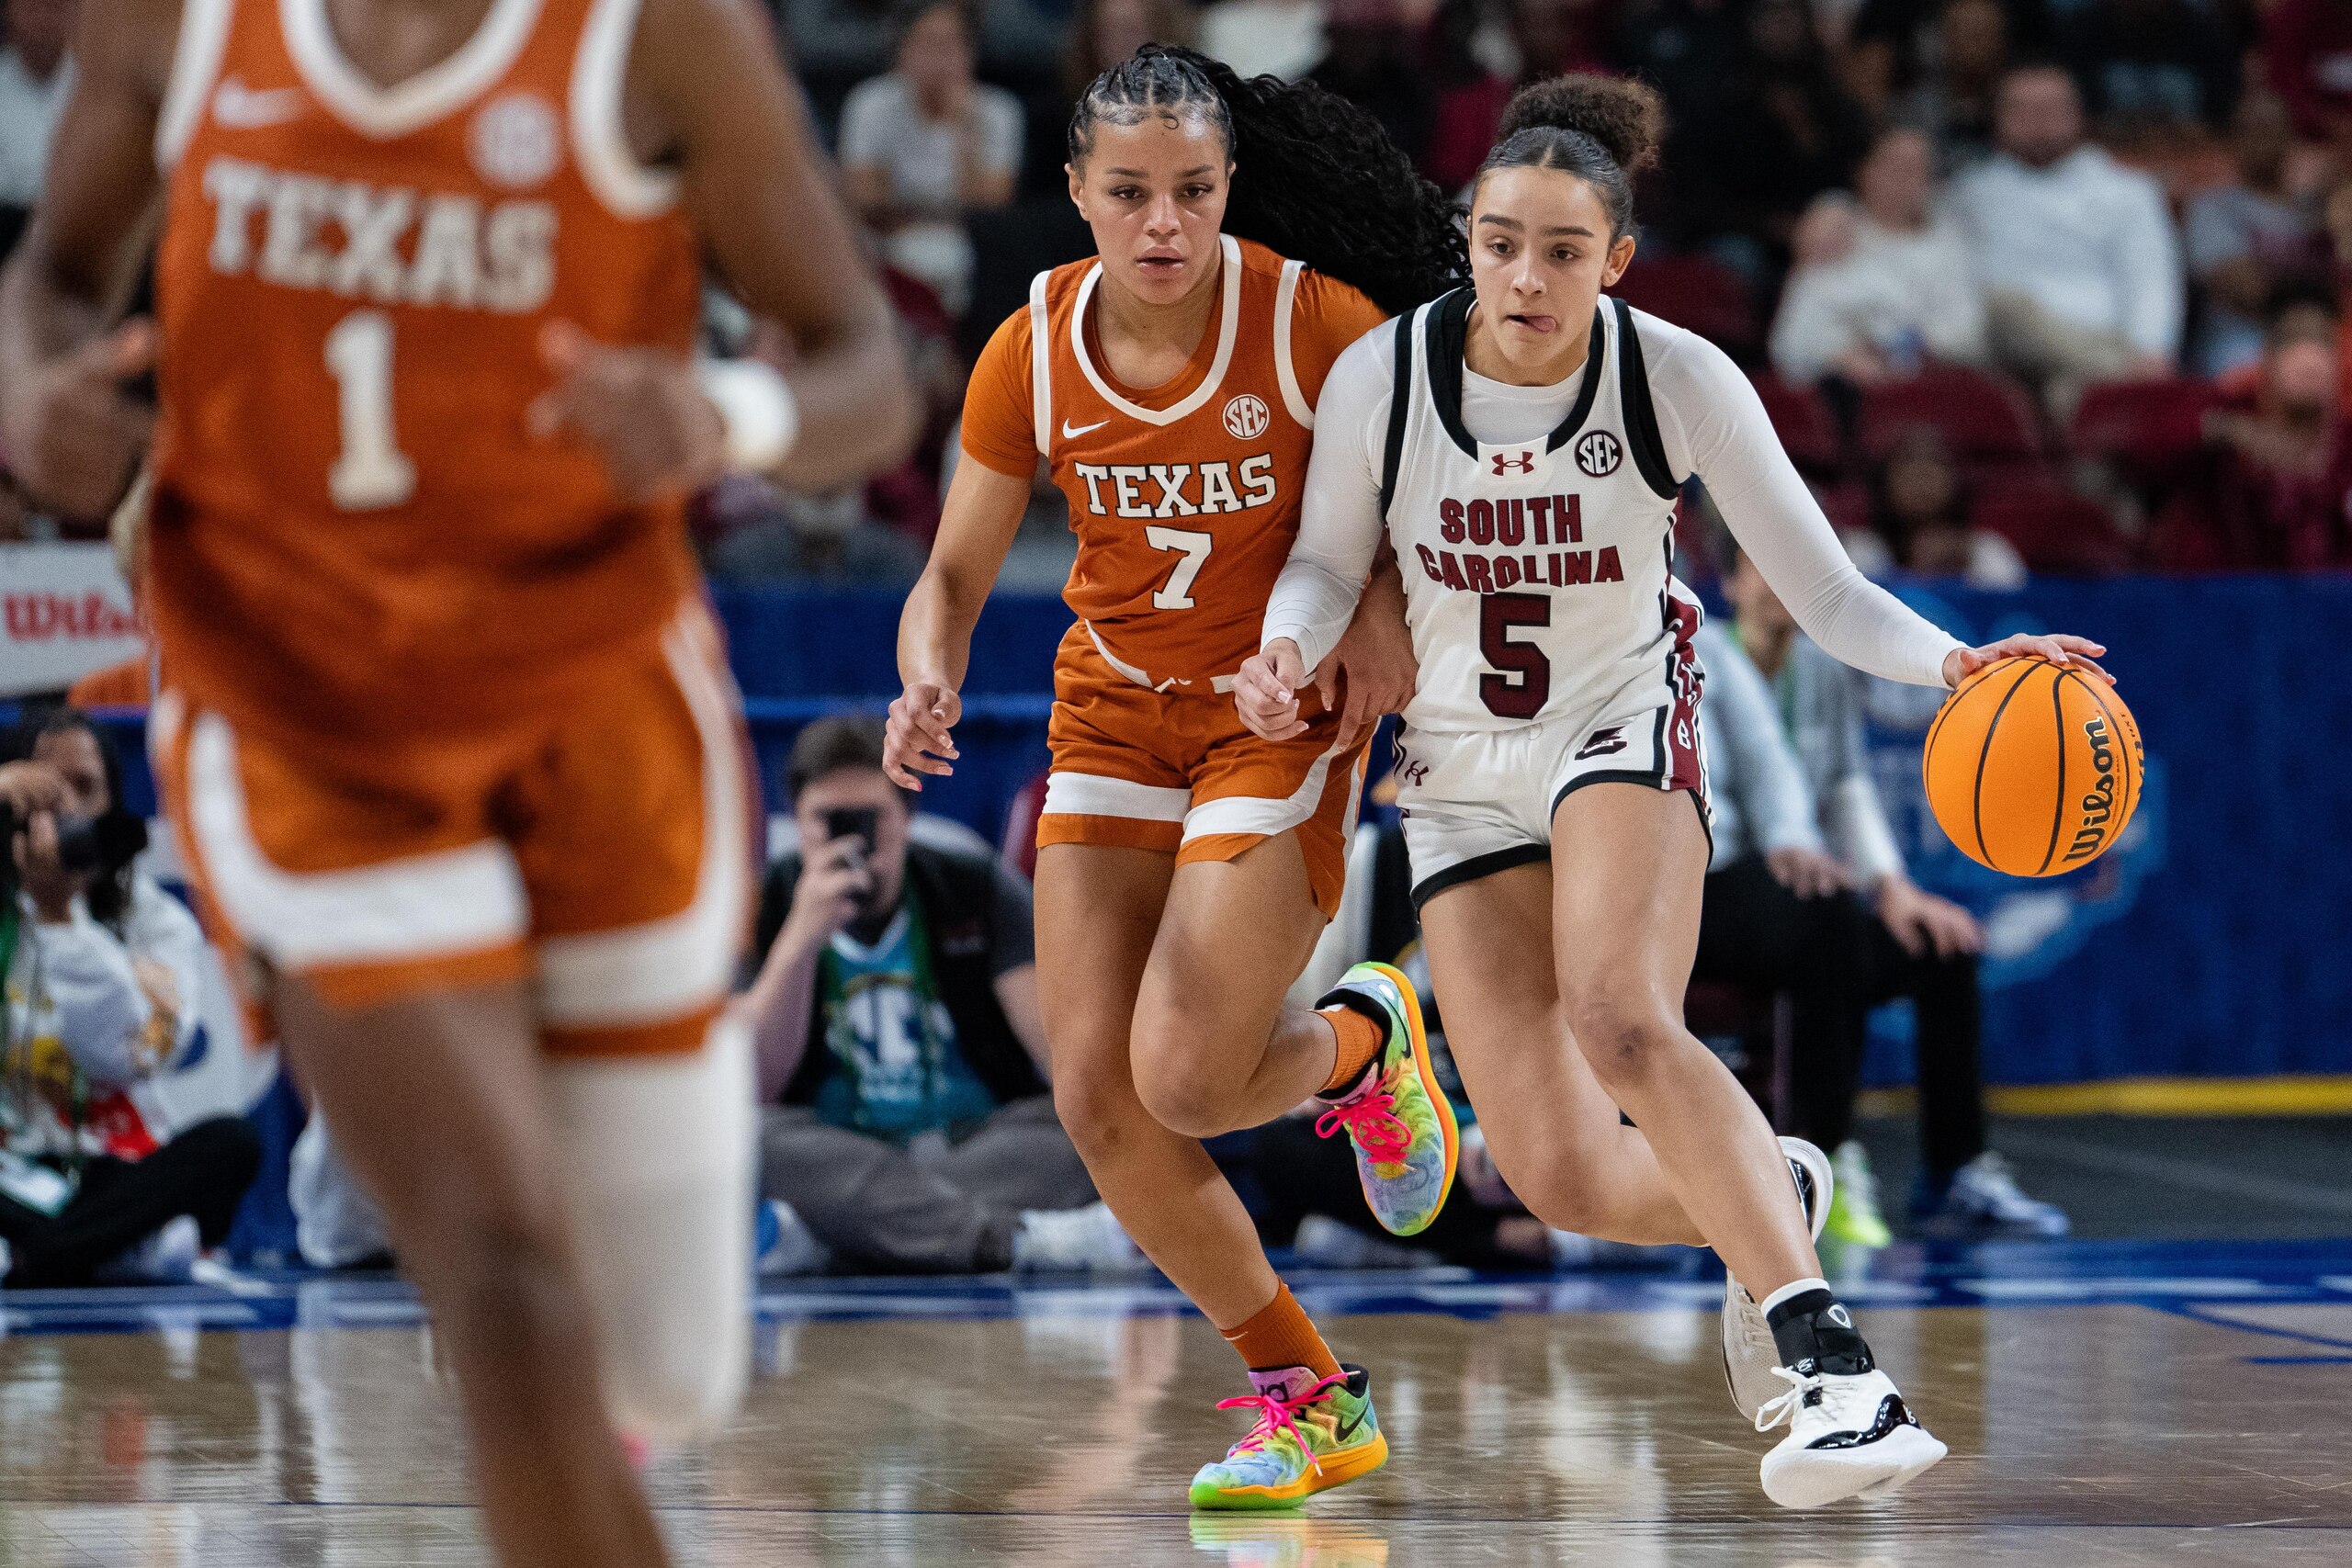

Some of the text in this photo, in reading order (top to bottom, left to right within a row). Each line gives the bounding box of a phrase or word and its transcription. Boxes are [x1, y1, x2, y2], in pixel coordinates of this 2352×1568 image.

[204, 157, 559, 313] TEXAS
[324, 310, 418, 511] 1
[1225, 396, 1268, 437] SEC
[1074, 453, 1277, 519] TEXAS
[1577, 433, 1621, 474] SEC
[1440, 493, 1583, 547] SOUTH
[1145, 525, 1213, 611] 7
[1415, 543, 1624, 594] CAROLINA
[1479, 592, 1551, 720] 5
[2062, 716, 2114, 862] Wilson
